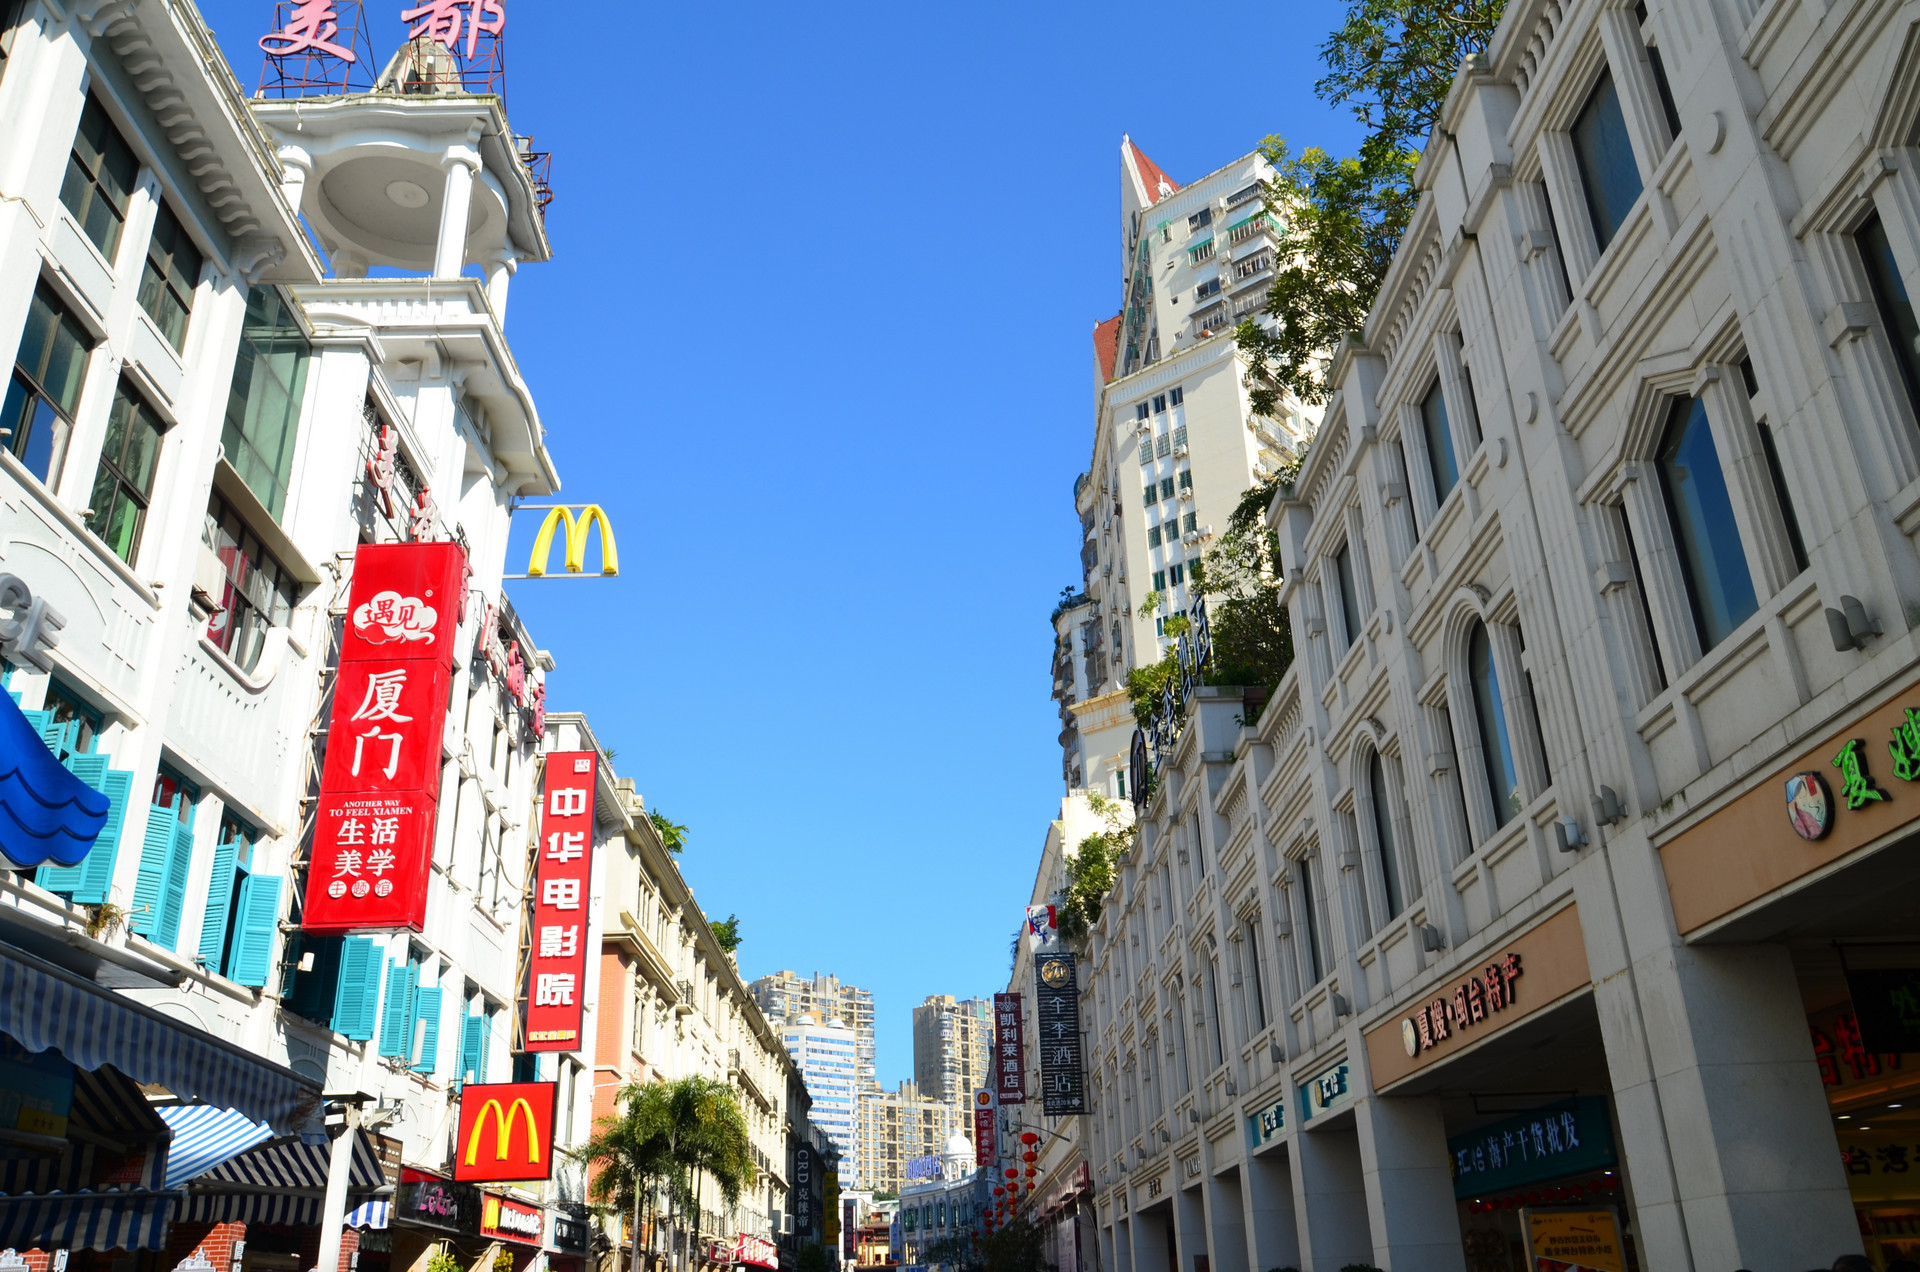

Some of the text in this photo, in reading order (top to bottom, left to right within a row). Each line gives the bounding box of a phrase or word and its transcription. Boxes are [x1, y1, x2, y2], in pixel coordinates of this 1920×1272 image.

[364, 599, 420, 631] 遇见
[351, 669, 413, 780] 厦门
[329, 806, 413, 817] TO FEEL XIAMEN
[343, 799, 401, 808] ANOTHER WAY
[336, 817, 400, 846] 生活
[332, 848, 396, 878] 美学
[328, 880, 393, 898] 主题馆
[534, 787, 587, 1007] 中华电影院
[1000, 1013, 1019, 1089] 凯利莱酒店
[797, 1150, 809, 1183] CRD
